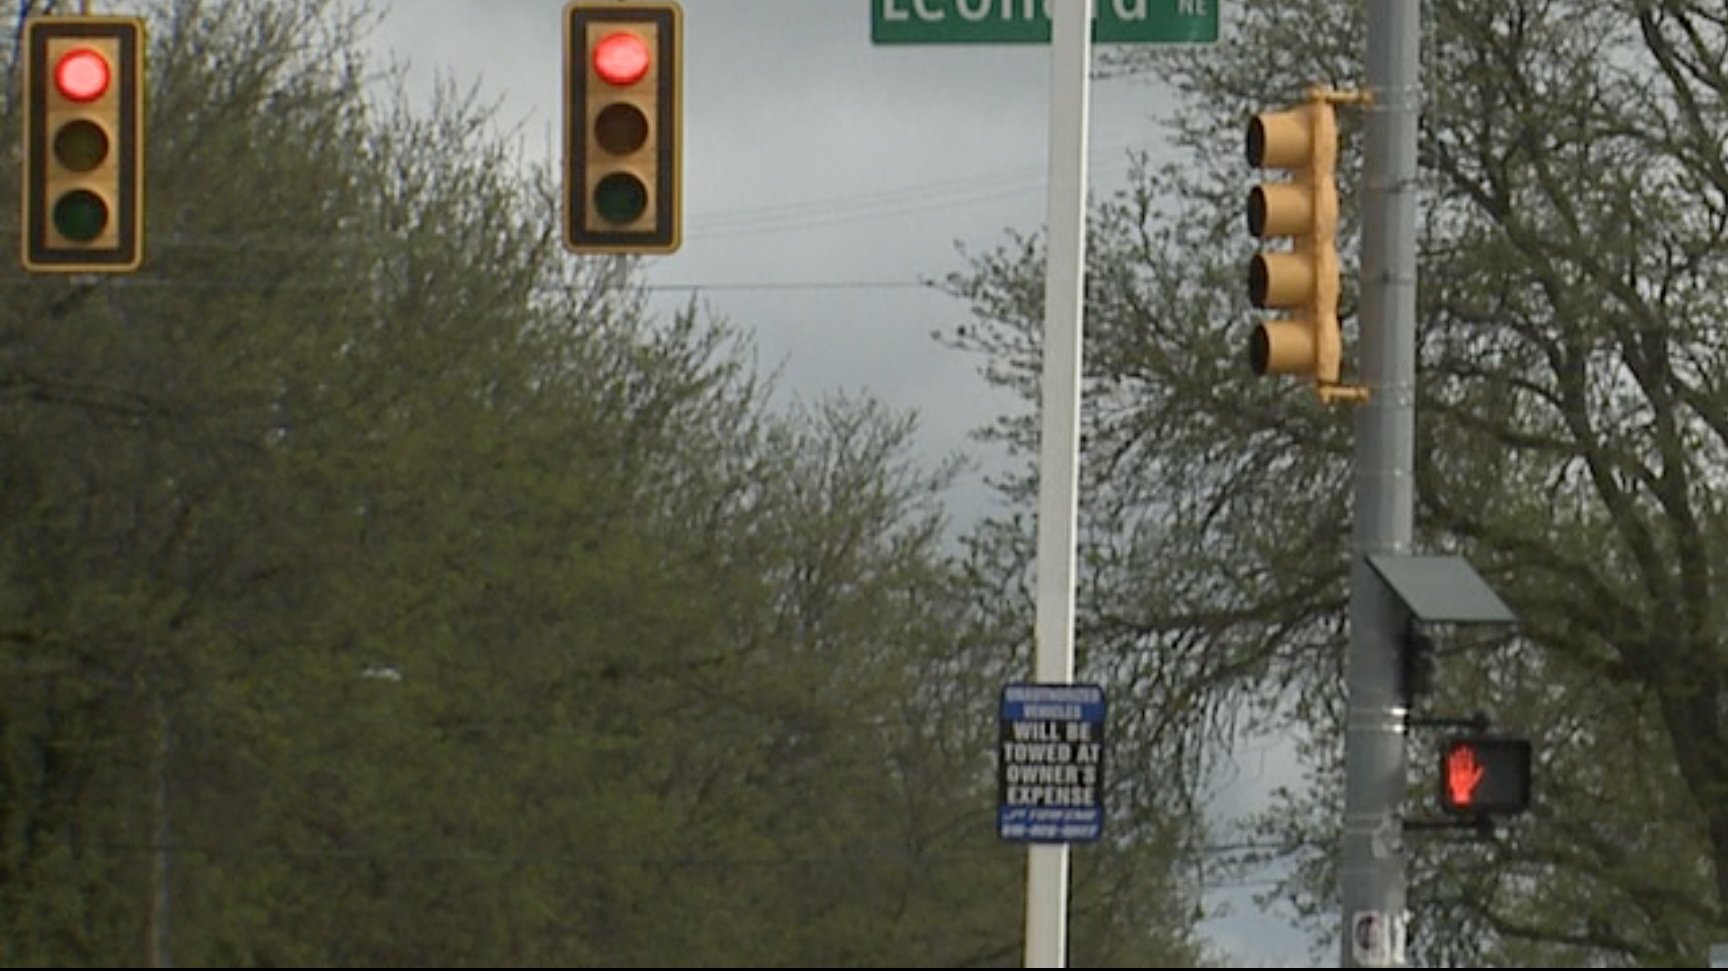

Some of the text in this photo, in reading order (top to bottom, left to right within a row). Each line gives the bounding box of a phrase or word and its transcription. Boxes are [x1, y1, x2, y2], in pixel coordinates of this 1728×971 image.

[1014, 720, 1091, 741] WILL BE
[1004, 743, 1100, 763] TOWED AT
[1007, 786, 1095, 805] EXPENSE
